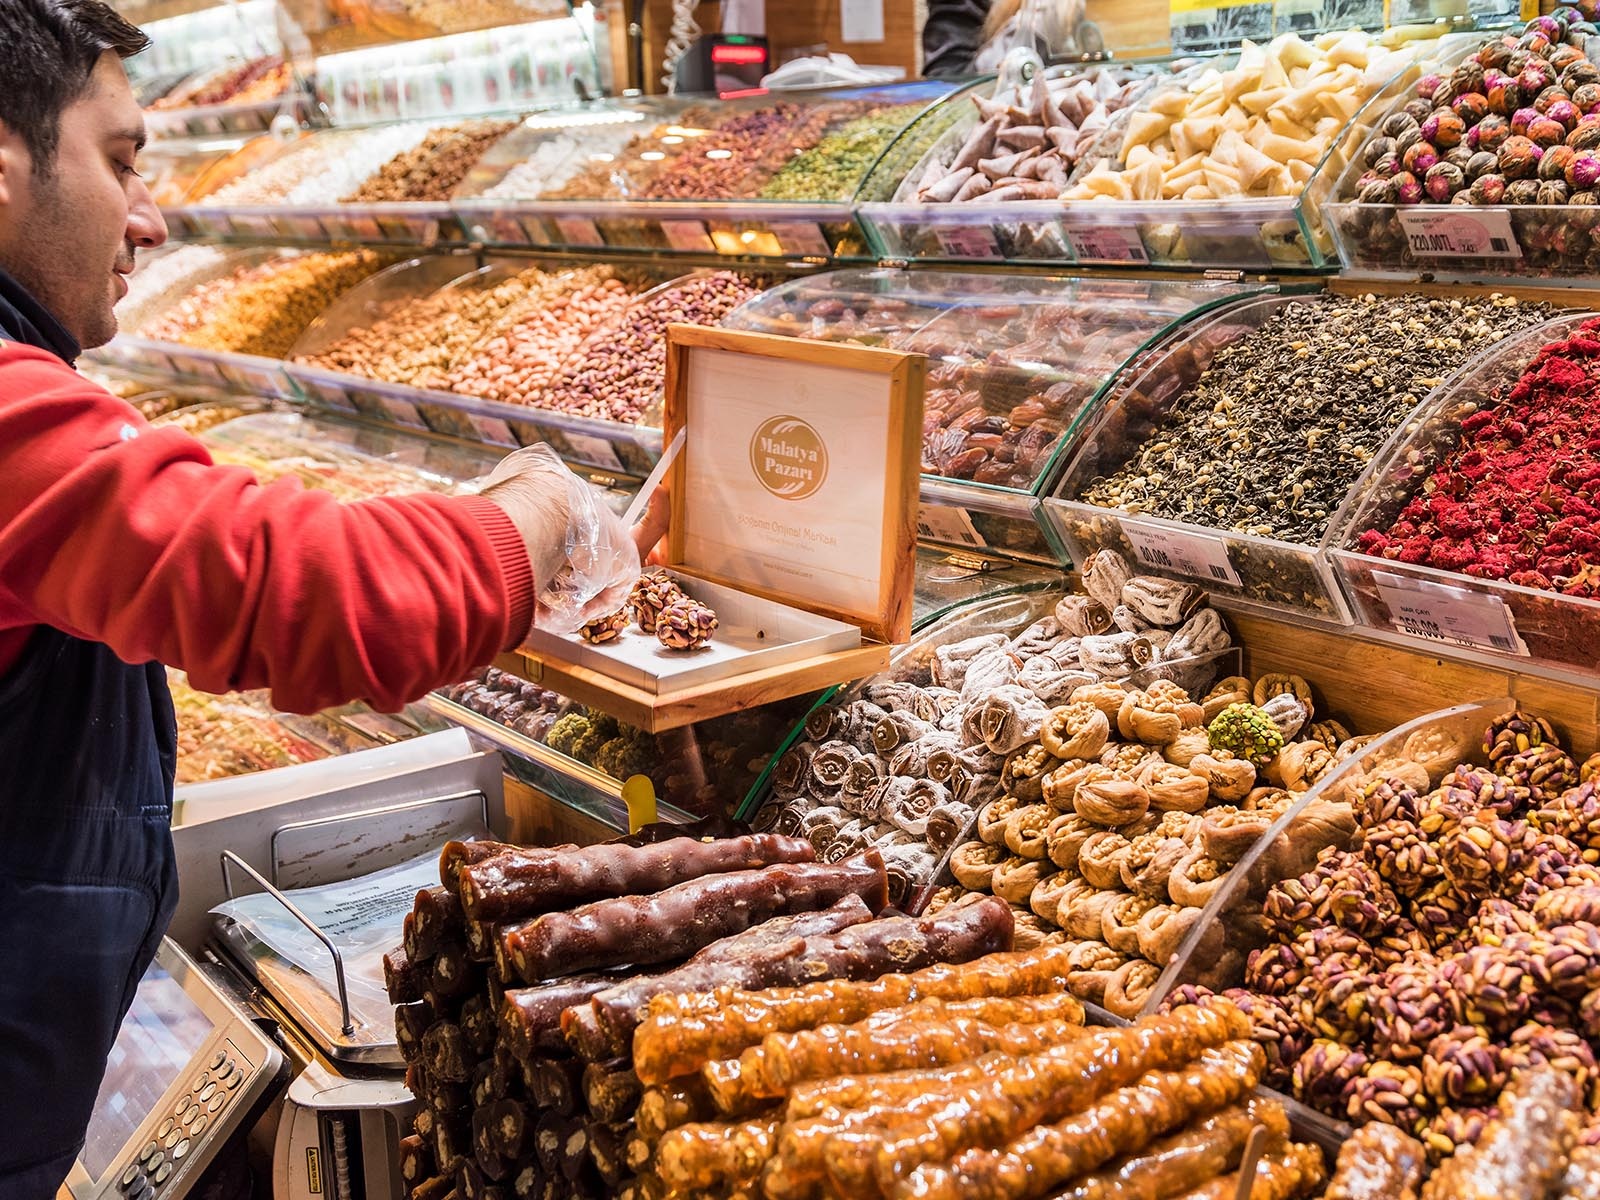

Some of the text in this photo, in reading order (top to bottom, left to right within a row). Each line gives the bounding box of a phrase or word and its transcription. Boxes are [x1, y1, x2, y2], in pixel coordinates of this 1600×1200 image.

[1410, 234, 1455, 251] 220.00TL
[760, 436, 818, 462] Malatya
[764, 457, 813, 481] Pazarı
